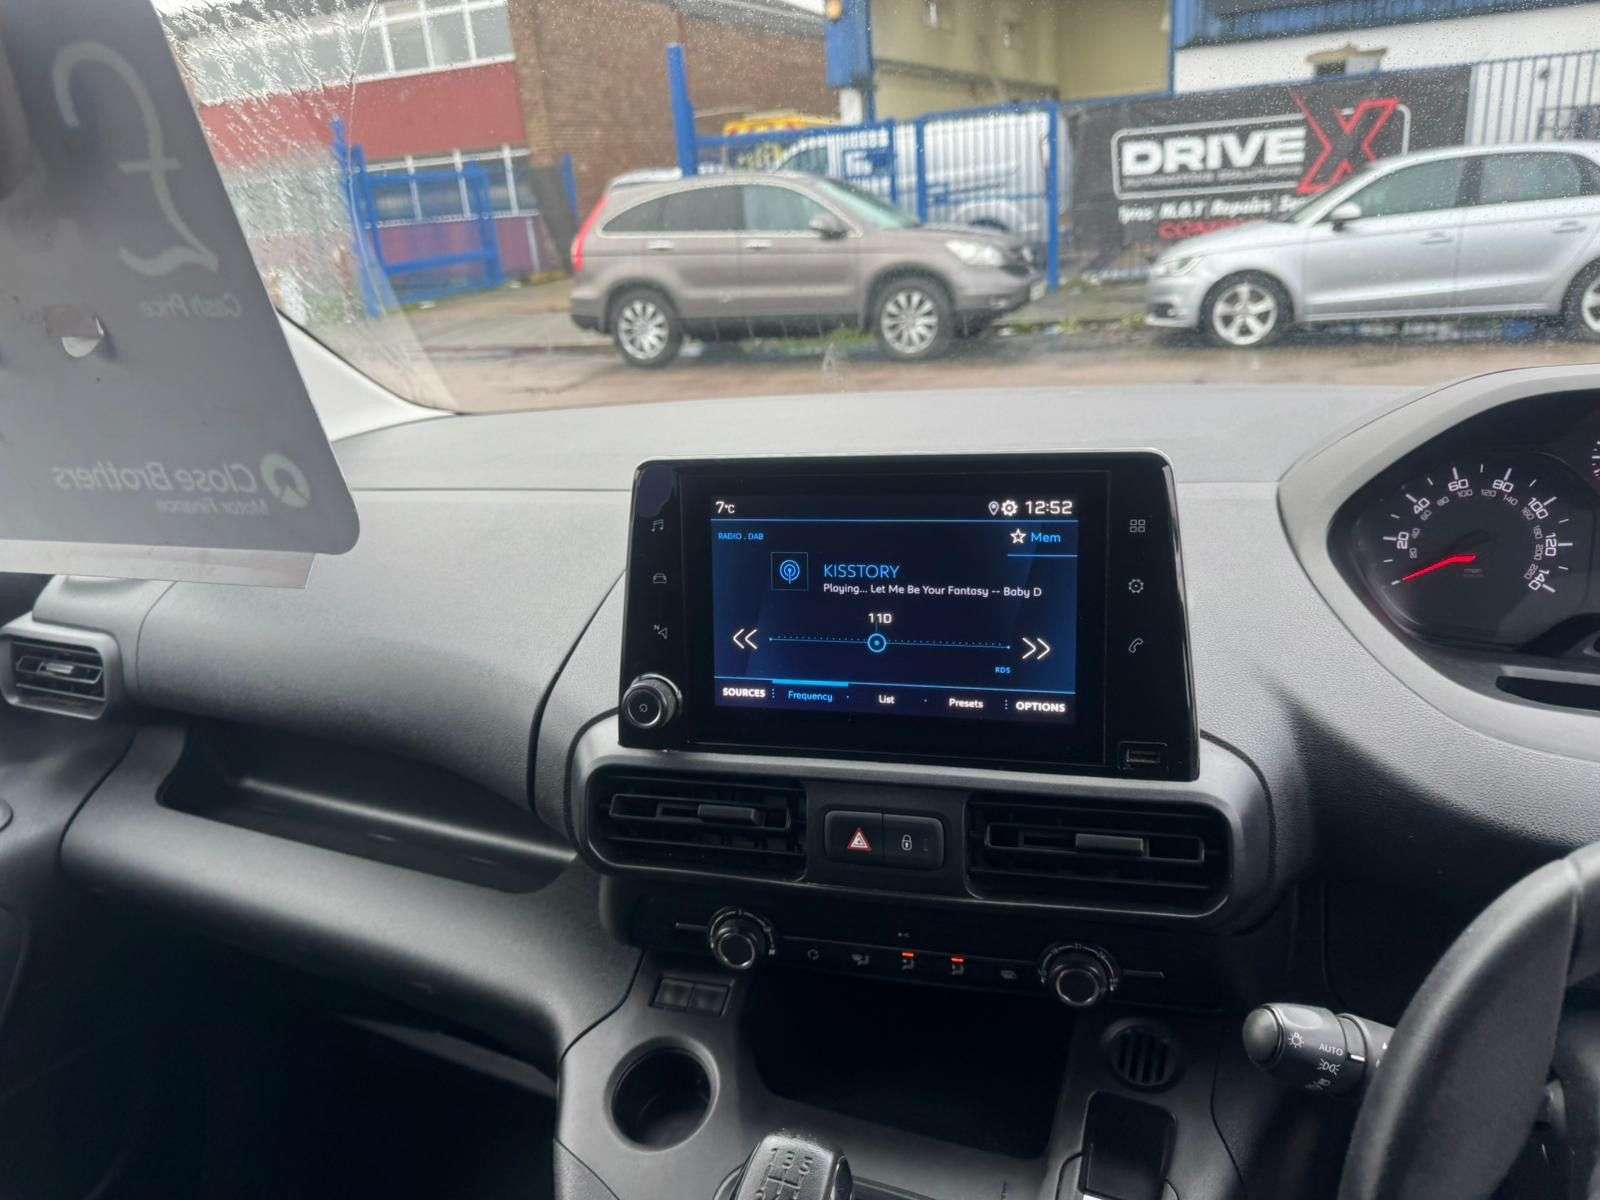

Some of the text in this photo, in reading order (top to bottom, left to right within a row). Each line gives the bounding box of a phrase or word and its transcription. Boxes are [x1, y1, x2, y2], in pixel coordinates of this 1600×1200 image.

[1121, 127, 1307, 177] DRIVE
[1448, 478, 1470, 491] 60
[1492, 479, 1514, 493] 80
[1457, 489, 1473, 498] 100
[1480, 488, 1497, 498] 120
[1503, 494, 1518, 506] 140
[1025, 500, 1073, 515] 12:52
[1412, 498, 1430, 515] 40
[1527, 497, 1549, 520] 100
[718, 532, 742, 541] RADIO
[748, 532, 764, 541] DAB
[1031, 532, 1061, 543] Mem
[1396, 531, 1409, 550] 20
[1545, 532, 1557, 557] 120
[824, 564, 900, 579] KISSTORY
[1528, 569, 1550, 591] 140
[871, 584, 886, 594] Let
[888, 585, 904, 594] Me
[907, 585, 920, 595] Be
[922, 586, 945, 595] Your
[948, 586, 989, 598] Fantasy
[1004, 586, 1030, 599] Baby
[1033, 587, 1042, 597] D
[995, 666, 1011, 674] RDS
[722, 687, 1066, 713] SOURCES Frequency List Presets OPTIONS
[1318, 1042, 1344, 1056] AUTO
[782, 1150, 796, 1169] 3
[799, 1155, 814, 1175] 5
